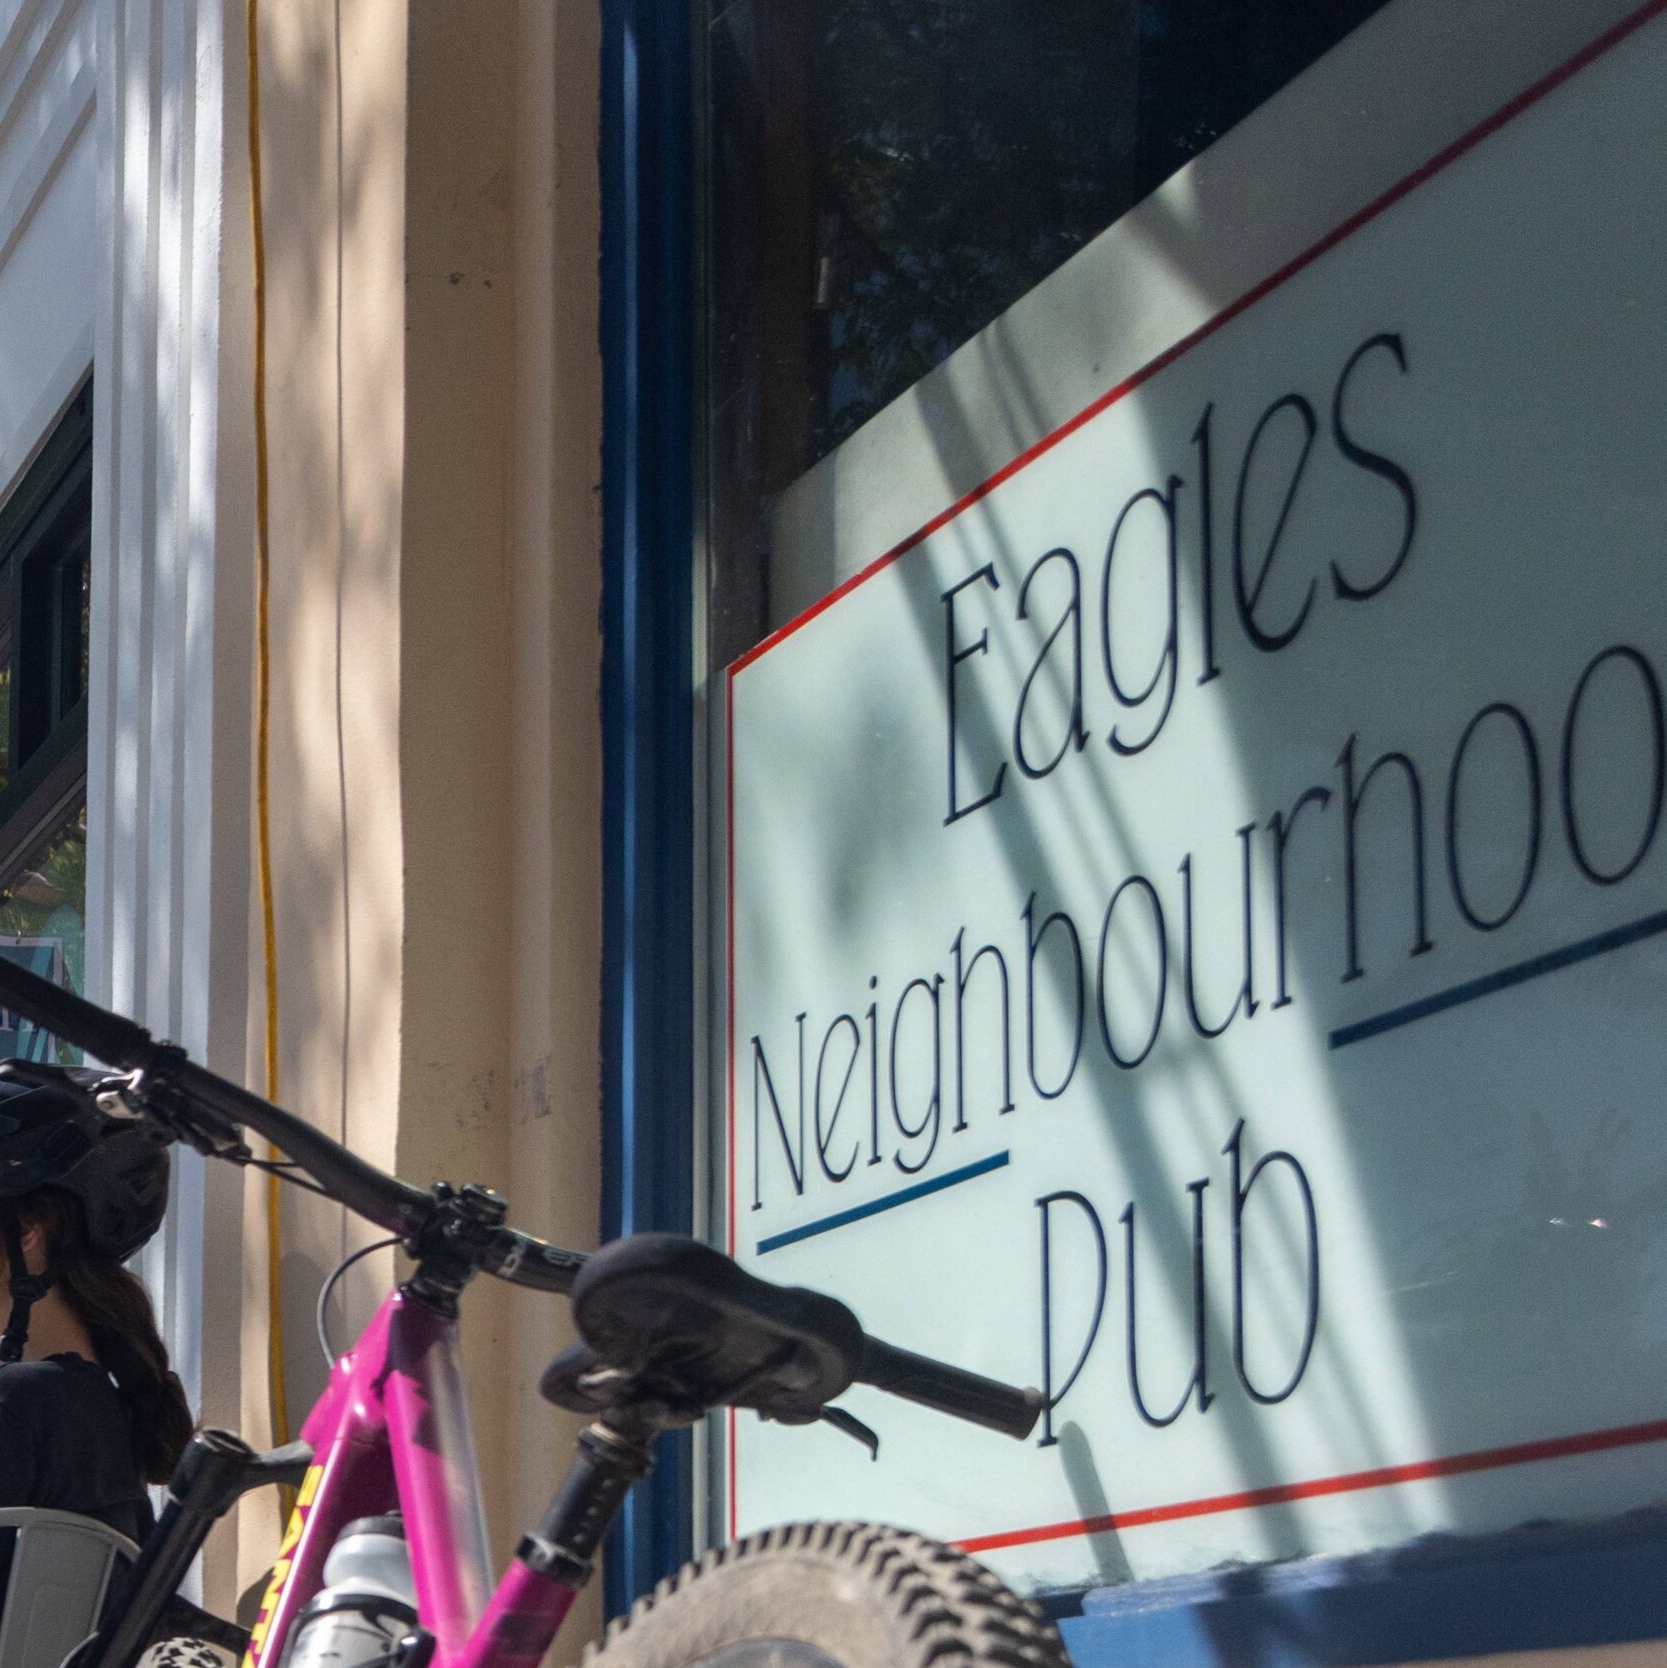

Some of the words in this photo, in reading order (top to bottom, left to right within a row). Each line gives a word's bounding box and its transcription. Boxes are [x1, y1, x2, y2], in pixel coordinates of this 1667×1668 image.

[941, 332, 1418, 827] Eagles
[750, 645, 1666, 1212] Neighbourhoo
[1034, 1117, 1322, 1449] Pub
